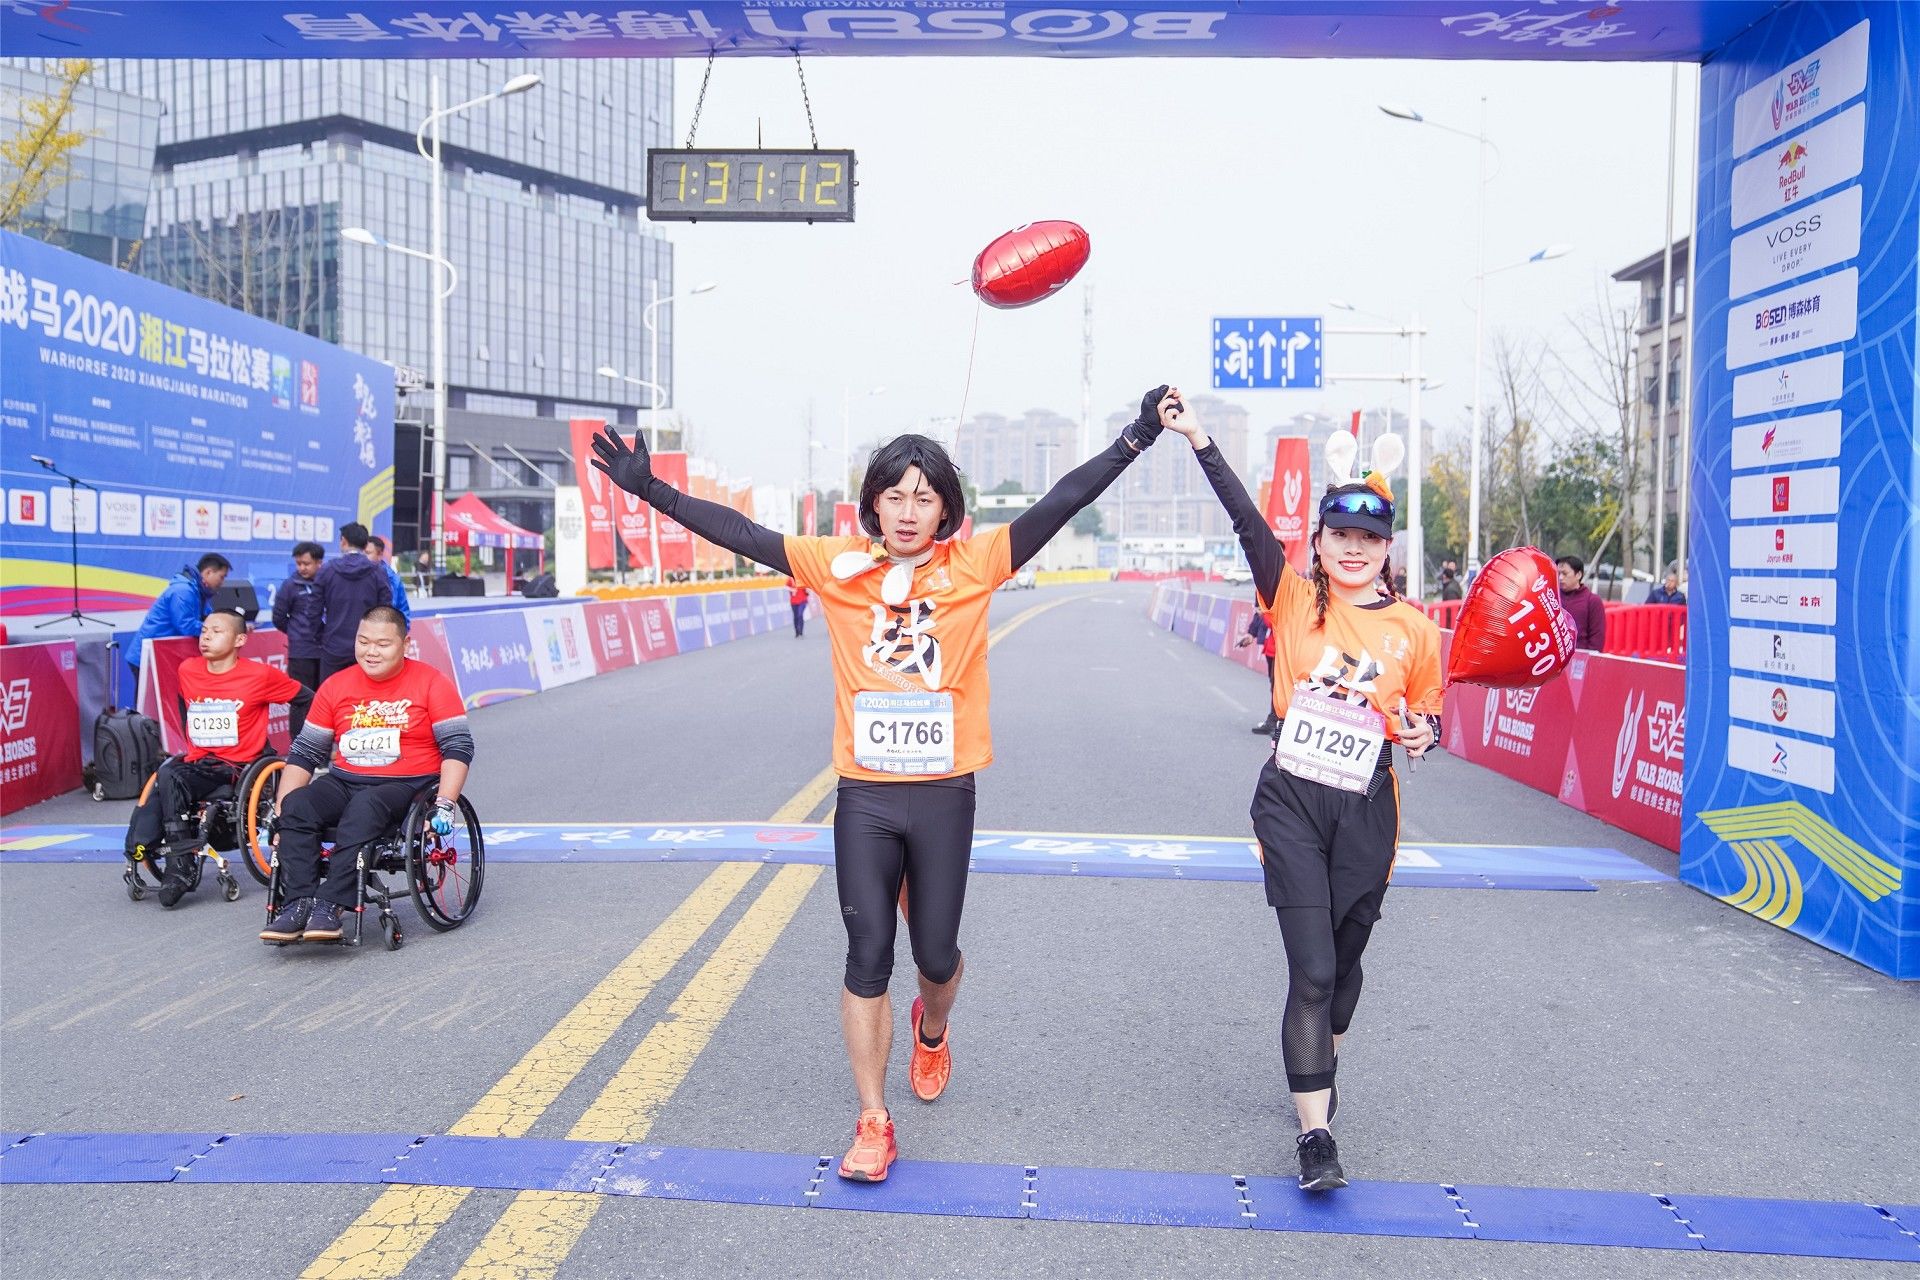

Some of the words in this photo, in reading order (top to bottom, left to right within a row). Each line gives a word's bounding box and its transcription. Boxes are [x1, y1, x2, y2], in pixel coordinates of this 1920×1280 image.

[283, 9, 722, 42] 博森体育
[677, 161, 842, 205] 1:31:12
[1784, 185, 1799, 202] 红牛
[1766, 214, 1822, 248] VOSS
[1772, 251, 1787, 265] LIVE
[1789, 242, 1812, 257] EVERY
[1789, 295, 1821, 320] 博森体育
[40, 346, 109, 378] WARHORSE
[110, 364, 137, 385] 2020
[138, 371, 200, 399] XIANGJIANG
[200, 385, 249, 409] MARATHON
[1741, 593, 1789, 606] BEIJING
[1799, 596, 1821, 608] 北京
[1507, 599, 1556, 676] 1:30
[193, 717, 231, 731] C1239
[869, 720, 943, 745] C1766
[1498, 714, 1512, 734] WAR
[1510, 718, 1535, 742] HORSE
[4, 736, 37, 763] HORSE
[348, 735, 391, 751] C1121
[1293, 719, 1372, 762] D1297
[1636, 759, 1658, 786] WAR
[1655, 766, 1684, 795] HORS
[1629, 784, 1683, 818] 能量型维生素饮
